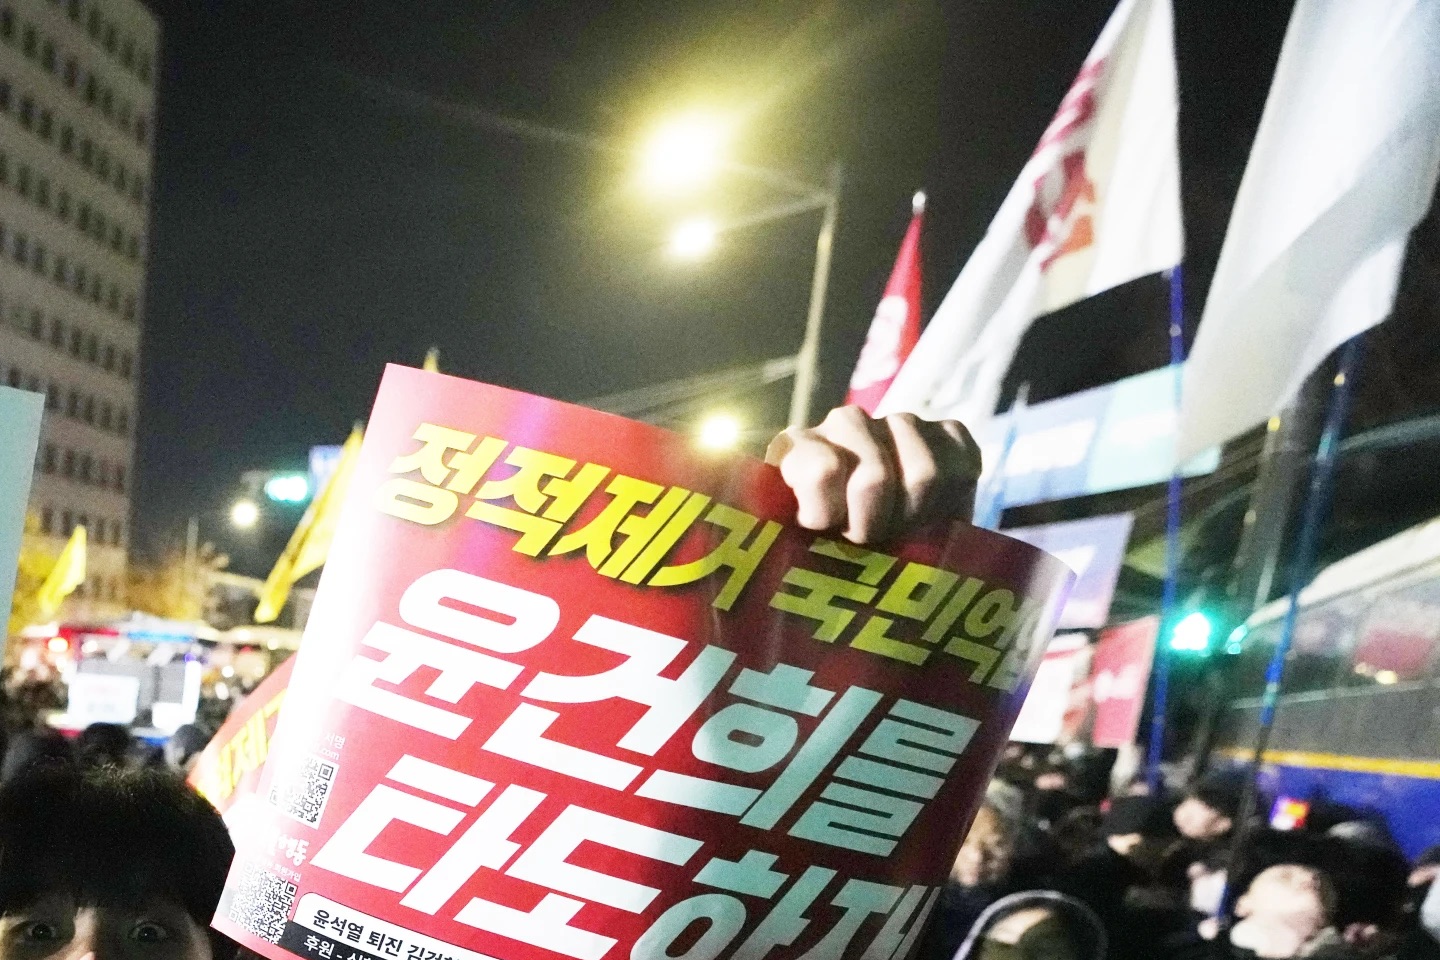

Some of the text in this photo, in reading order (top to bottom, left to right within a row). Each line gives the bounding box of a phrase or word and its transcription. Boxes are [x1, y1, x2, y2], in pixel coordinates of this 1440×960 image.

[371, 423, 782, 611] 정적제거
[330, 568, 982, 857] 윤건희를
[303, 934, 335, 960] 후원
[313, 909, 364, 943] 윤석열
[367, 931, 403, 957] 퇴진
